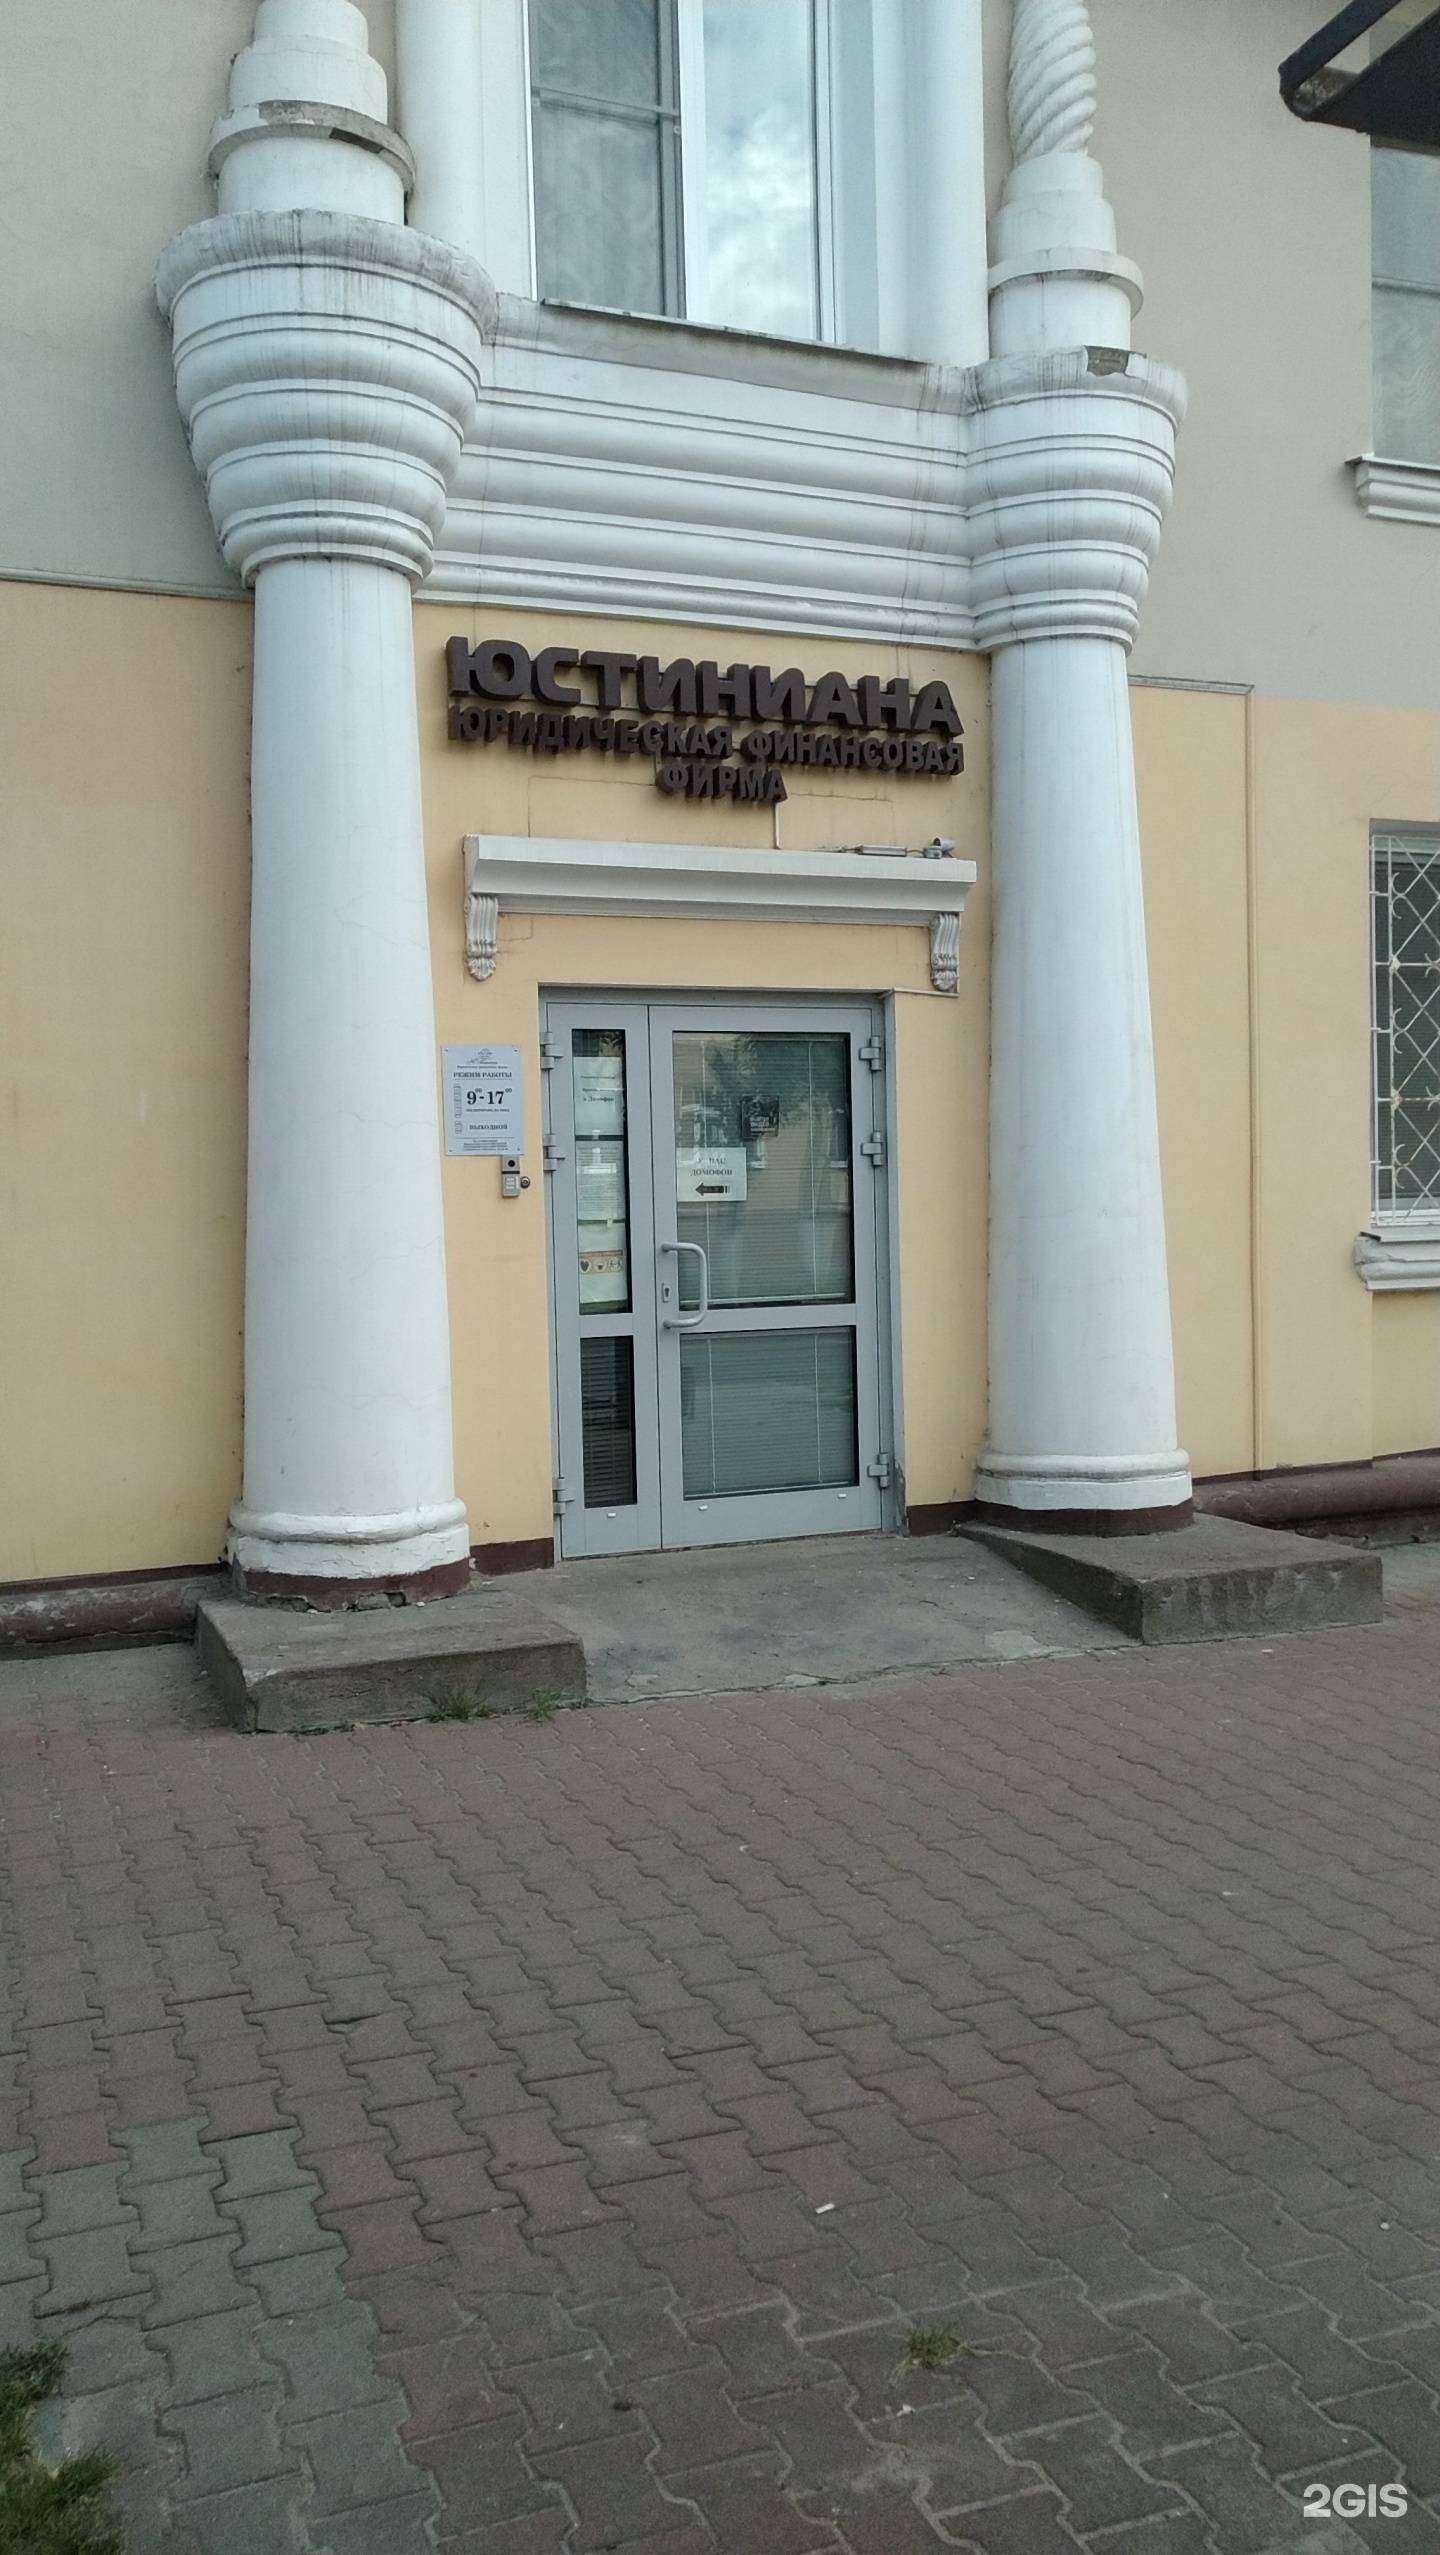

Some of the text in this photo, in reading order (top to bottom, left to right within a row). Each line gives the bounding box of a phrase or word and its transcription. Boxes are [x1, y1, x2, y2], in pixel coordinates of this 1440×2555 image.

[445, 635, 964, 737] ЮСТИНИАНА
[448, 704, 965, 776] ЮРИДИЧЕСКАЯ ФИНАНСОВАЯ
[656, 762, 788, 802] ФИРМА
